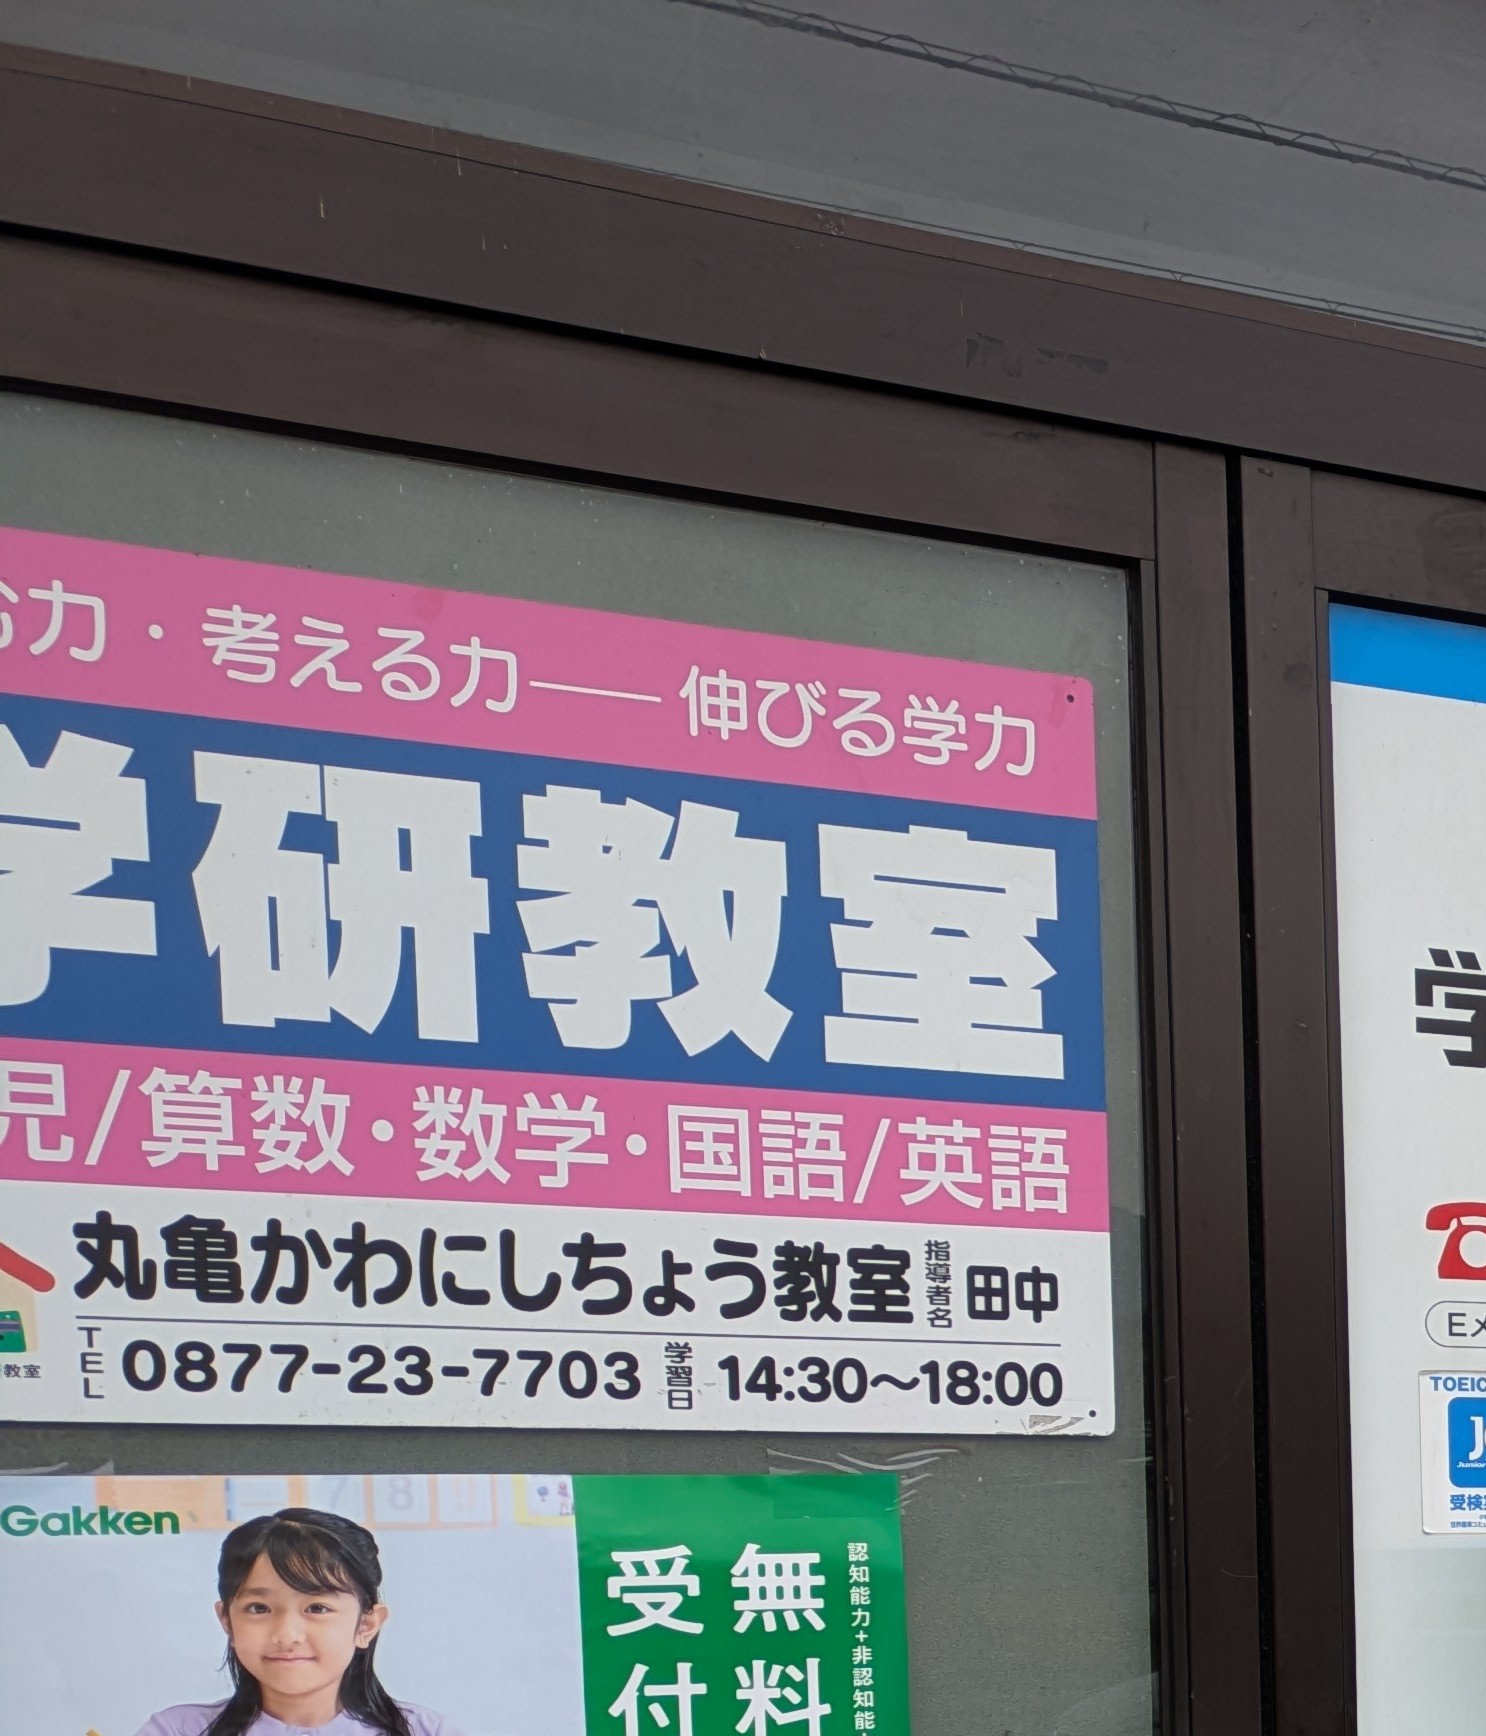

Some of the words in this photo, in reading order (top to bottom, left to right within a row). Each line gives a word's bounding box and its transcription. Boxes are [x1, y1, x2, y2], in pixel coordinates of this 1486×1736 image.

[73, 1210, 914, 1323] 丸亀かわにしちょう教室
[924, 1240, 953, 1329] 指導者名
[966, 1265, 1059, 1323] 田中
[0, 1364, 41, 1379] 教室
[122, 1339, 641, 1400] 0877-23-7703
[664, 1342, 694, 1411] 学習日
[0, 1505, 181, 1537] Gakken
